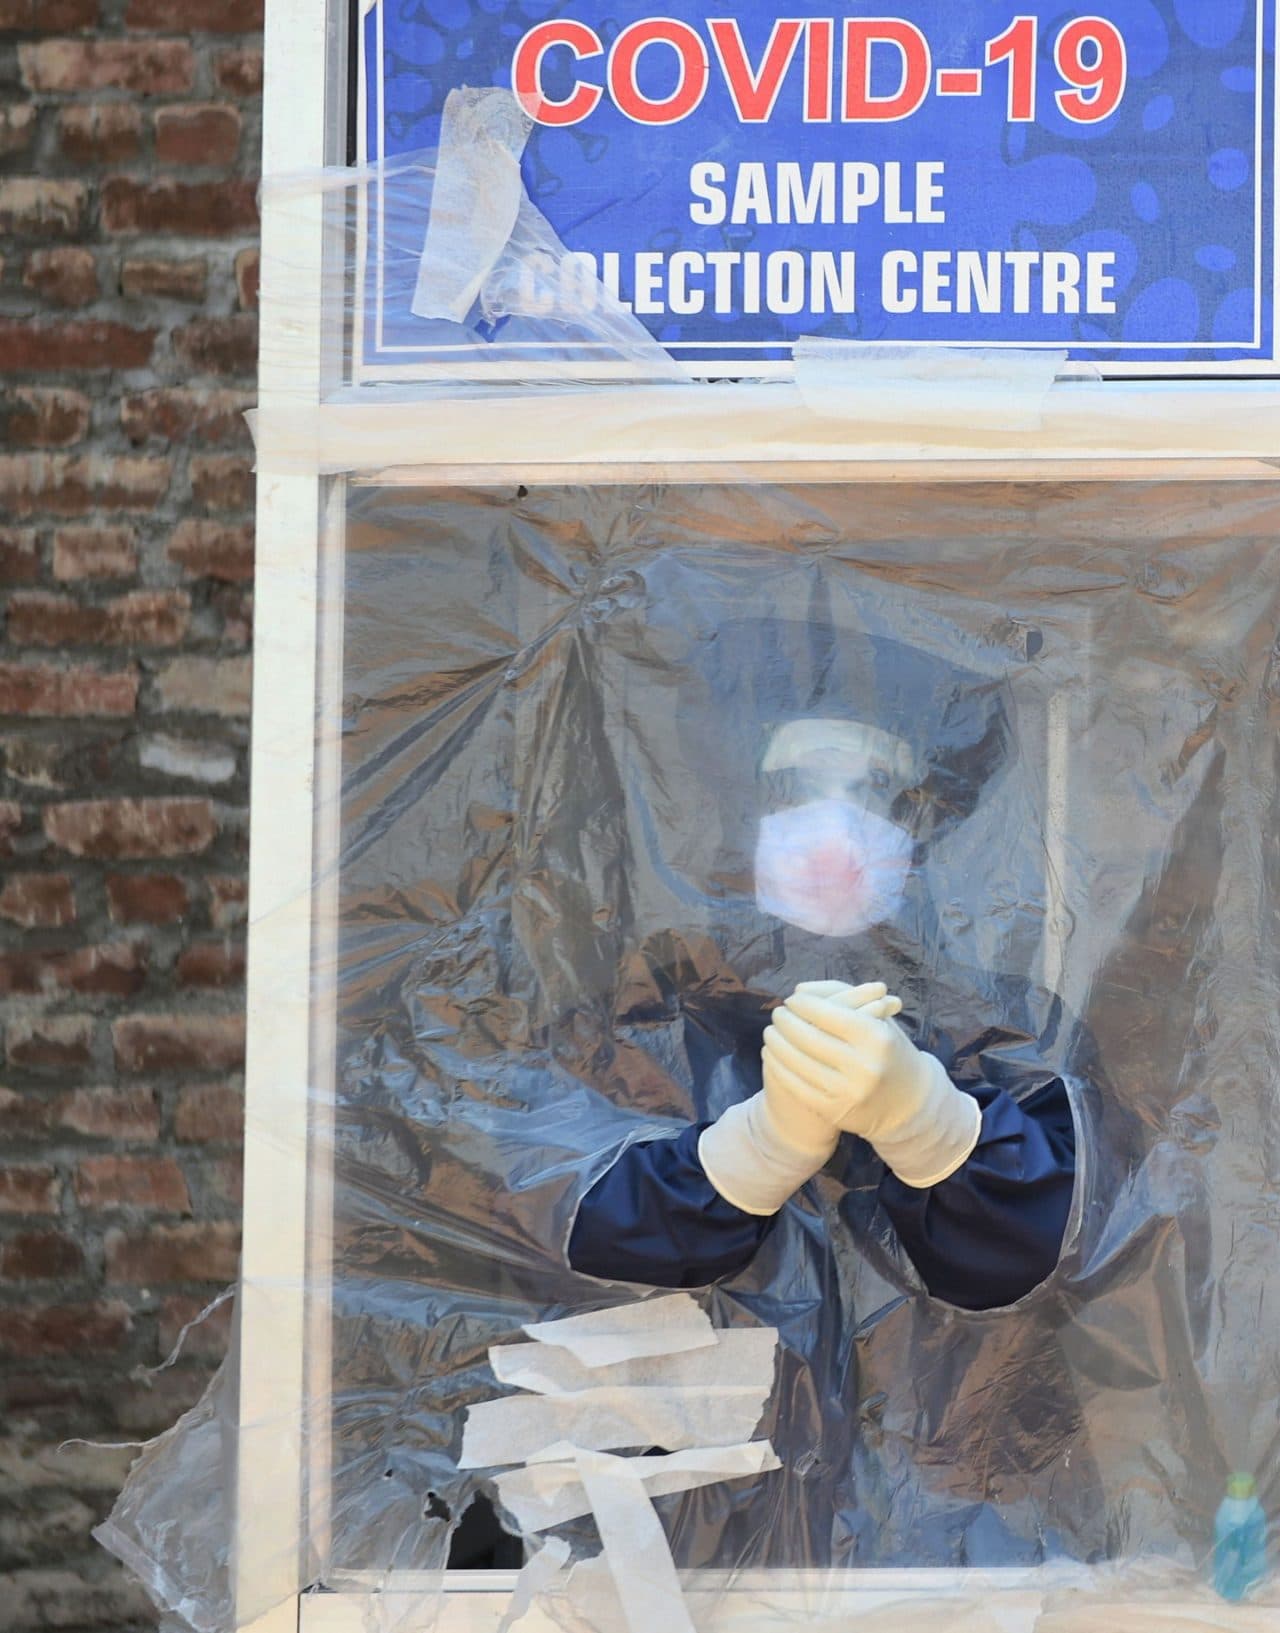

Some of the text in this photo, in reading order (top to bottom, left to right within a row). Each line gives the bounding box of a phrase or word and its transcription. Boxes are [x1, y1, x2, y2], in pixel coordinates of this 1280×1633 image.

[510, 16, 1128, 127] COVID-19
[688, 161, 946, 227] SAMPLE
[880, 248, 1117, 316] CENTRE
